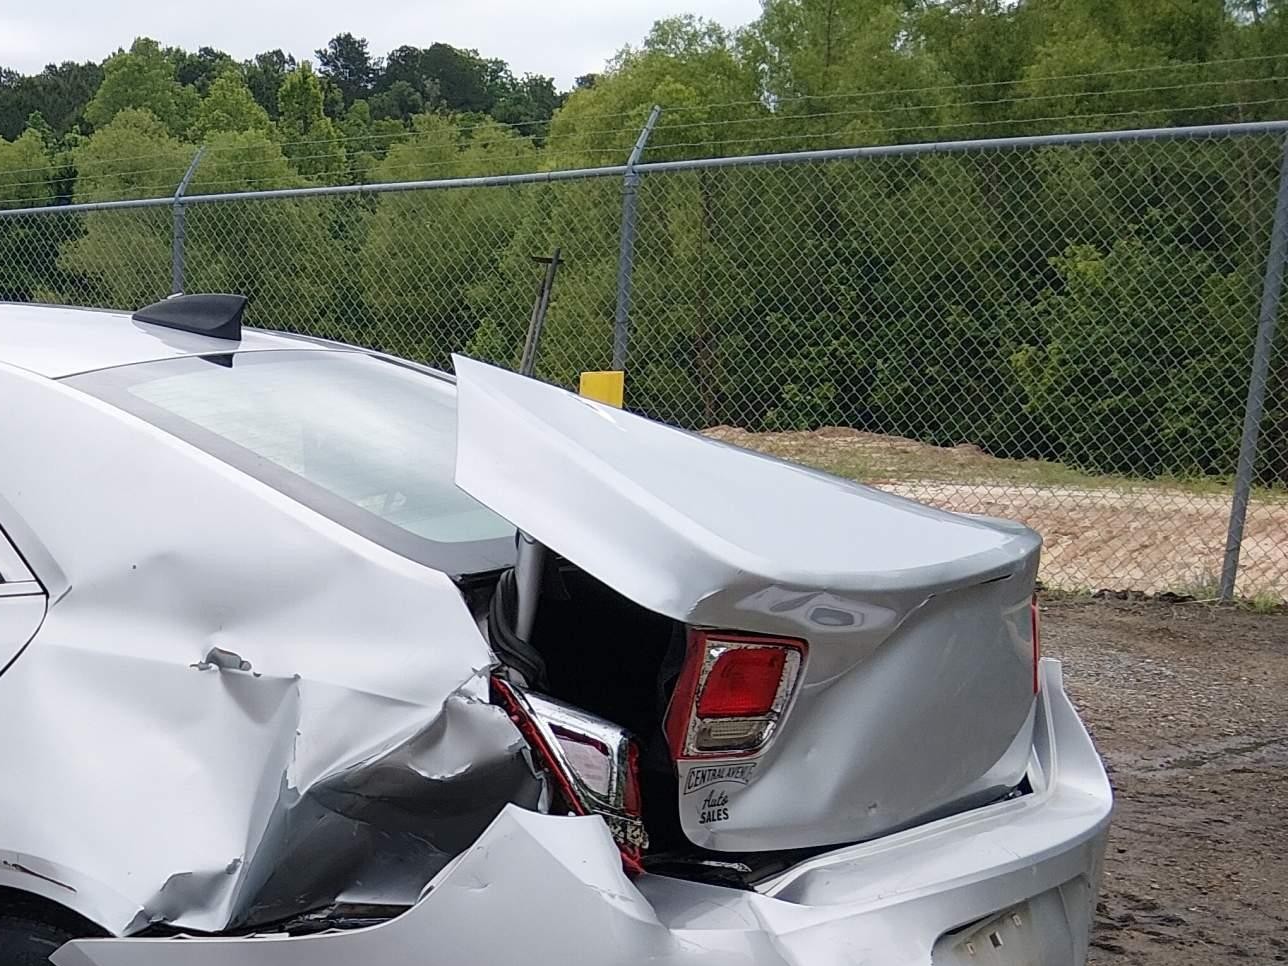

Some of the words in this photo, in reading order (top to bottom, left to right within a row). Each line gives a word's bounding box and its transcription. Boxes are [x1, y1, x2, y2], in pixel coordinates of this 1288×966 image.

[688, 768, 724, 790] CENTRAL
[702, 790, 729, 810] Auto
[699, 808, 730, 824] SALES
